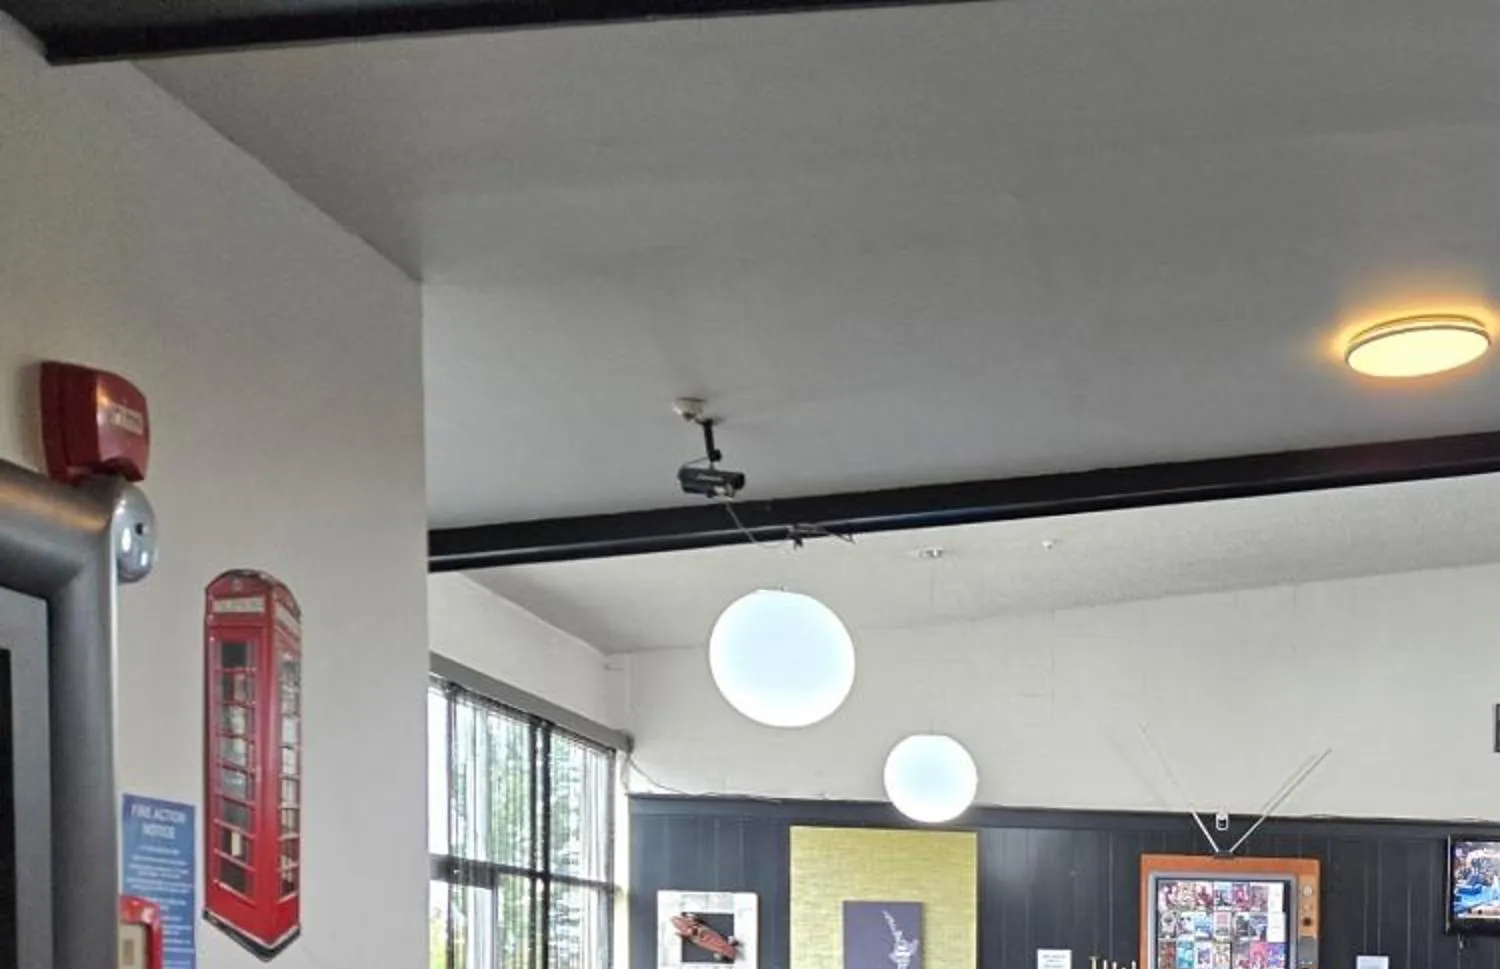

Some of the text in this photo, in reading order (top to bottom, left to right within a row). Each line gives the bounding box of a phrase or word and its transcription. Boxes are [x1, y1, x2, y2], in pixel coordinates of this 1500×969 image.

[130, 803, 186, 824] FIRE ACTION
[142, 822, 176, 840] NOTICE
